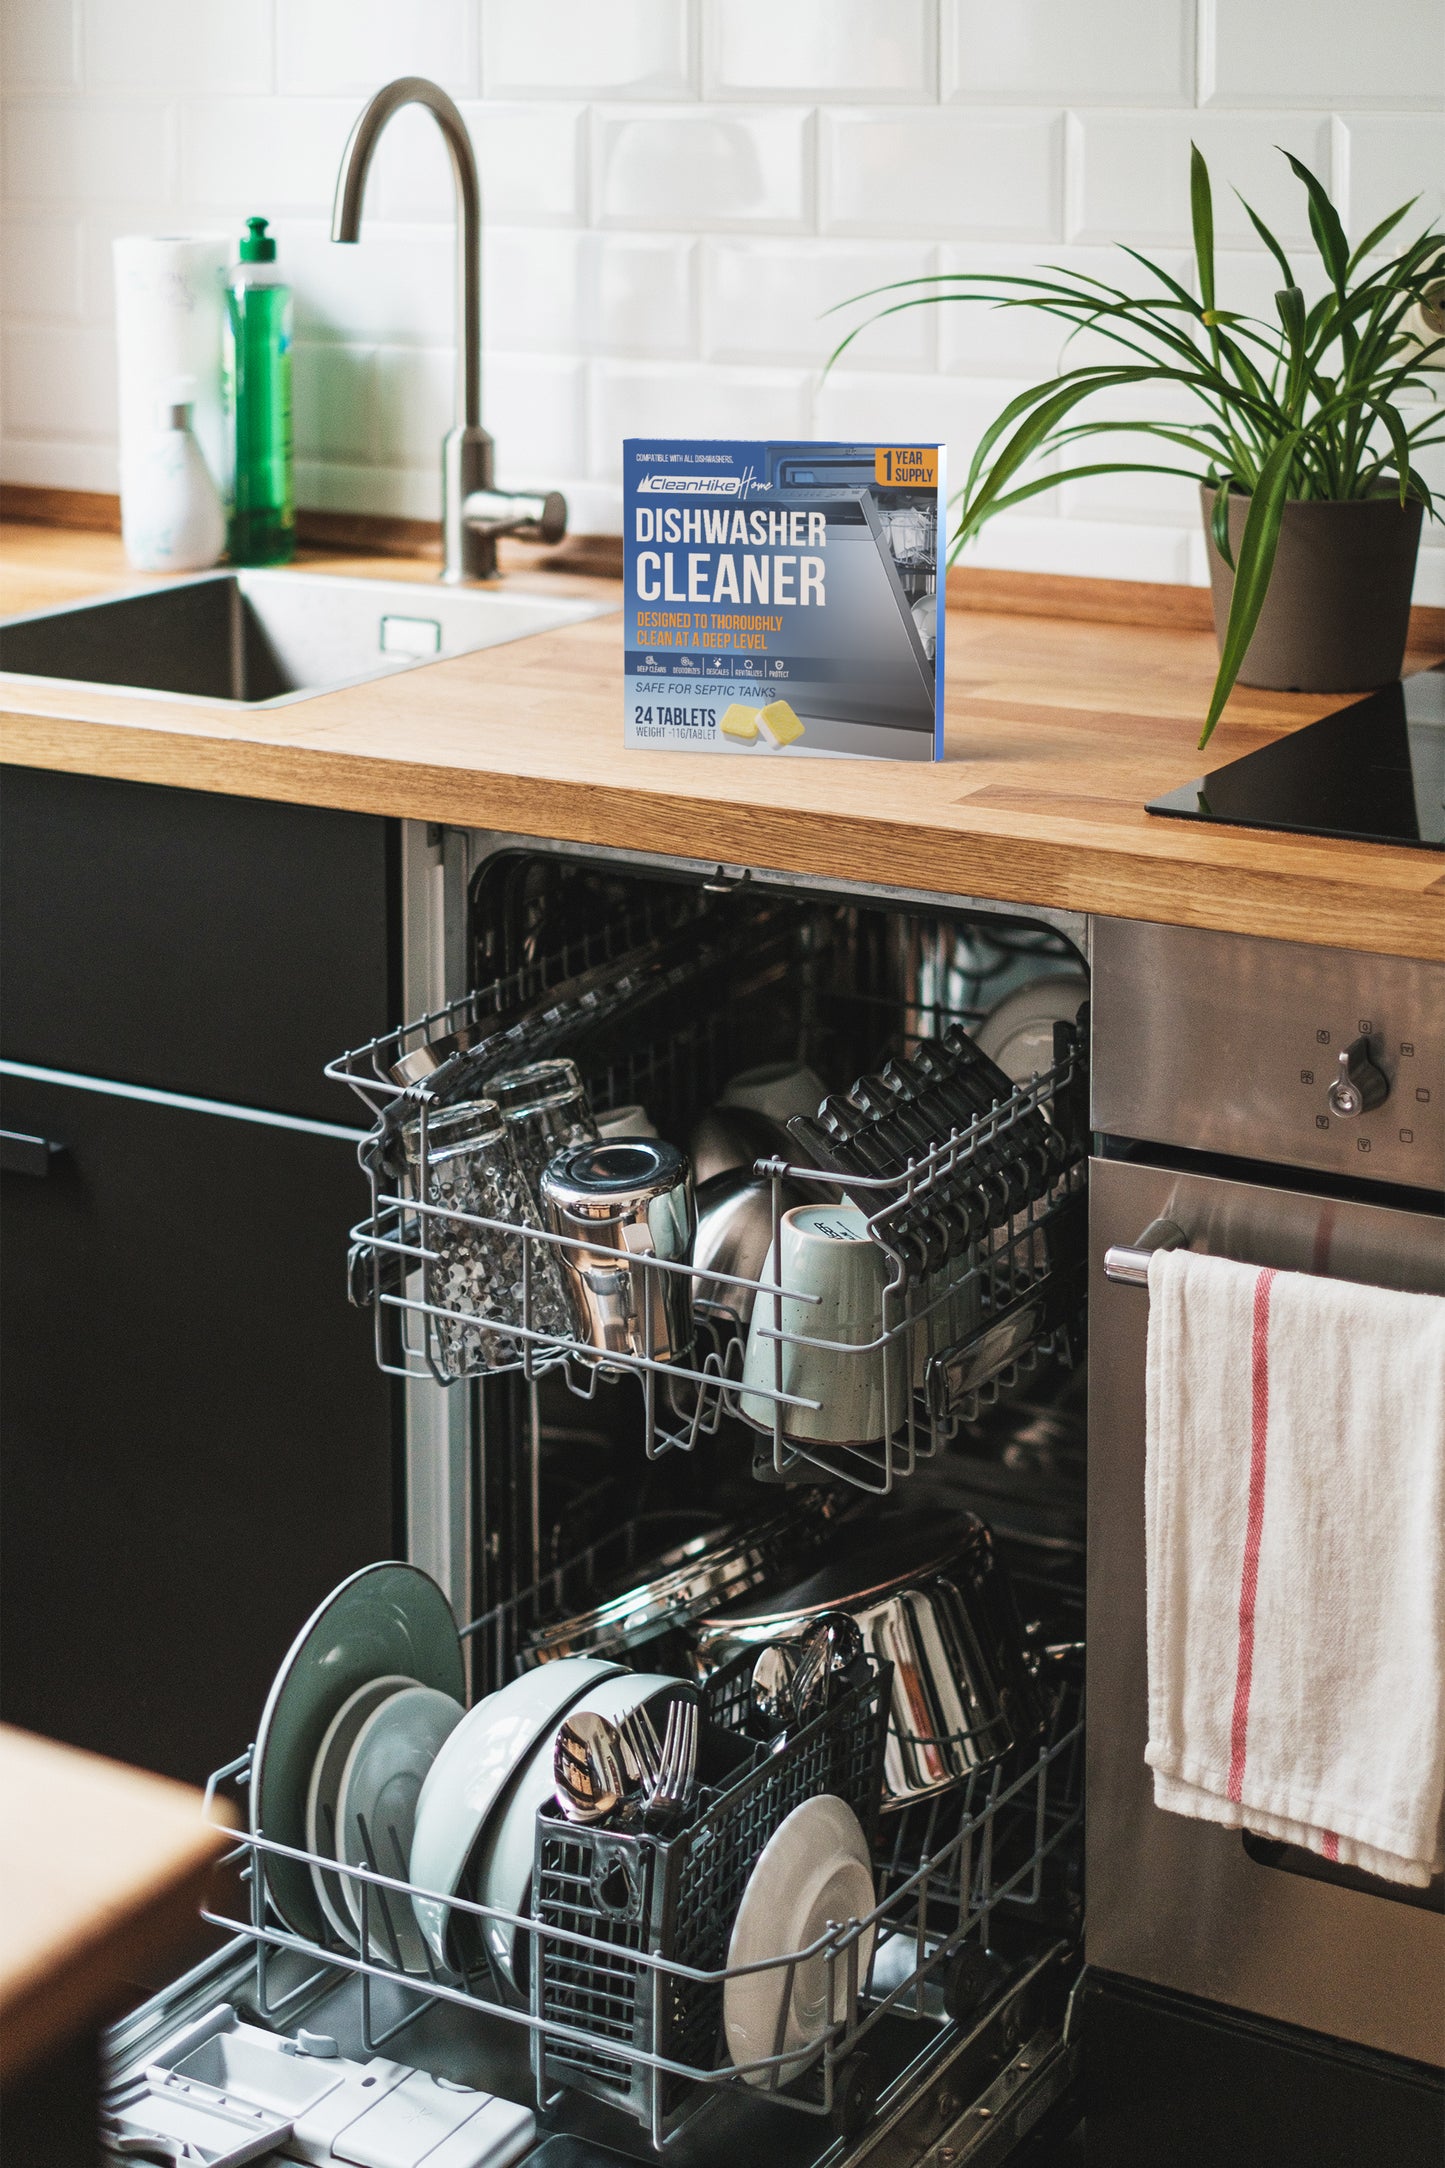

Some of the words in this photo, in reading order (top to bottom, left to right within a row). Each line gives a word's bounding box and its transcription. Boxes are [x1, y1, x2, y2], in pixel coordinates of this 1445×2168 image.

[636, 453, 668, 463] COMPATIBLE
[669, 454, 683, 463] WITH
[684, 455, 694, 463] ALL
[883, 450, 892, 481] 1
[895, 451, 923, 465] YEAR
[650, 477, 736, 492] CleanHike
[737, 466, 774, 500] Home
[895, 467, 933, 483] SUPPLY
[636, 507, 827, 547] DISHWASHER
[636, 551, 826, 606] CLEANER
[637, 612, 691, 628] DESIGNED
[694, 615, 708, 629] TO
[711, 615, 783, 631] THOROUGHLY
[637, 631, 672, 646] CLEAN
[676, 632, 688, 646] AT
[692, 633, 700, 647] A
[703, 633, 730, 648] DEEP
[734, 634, 768, 650] LEVEL
[637, 665, 649, 673] DEEP
[769, 670, 789, 678] PROTECT
[636, 683, 665, 693] SAFE
[668, 684, 691, 694] FOR
[694, 685, 735, 696] SEPTIC
[739, 687, 776, 697] TANKS
[635, 706, 653, 725] 24
[657, 707, 716, 727] TABLETS
[636, 727, 665, 737] WEIGHT
